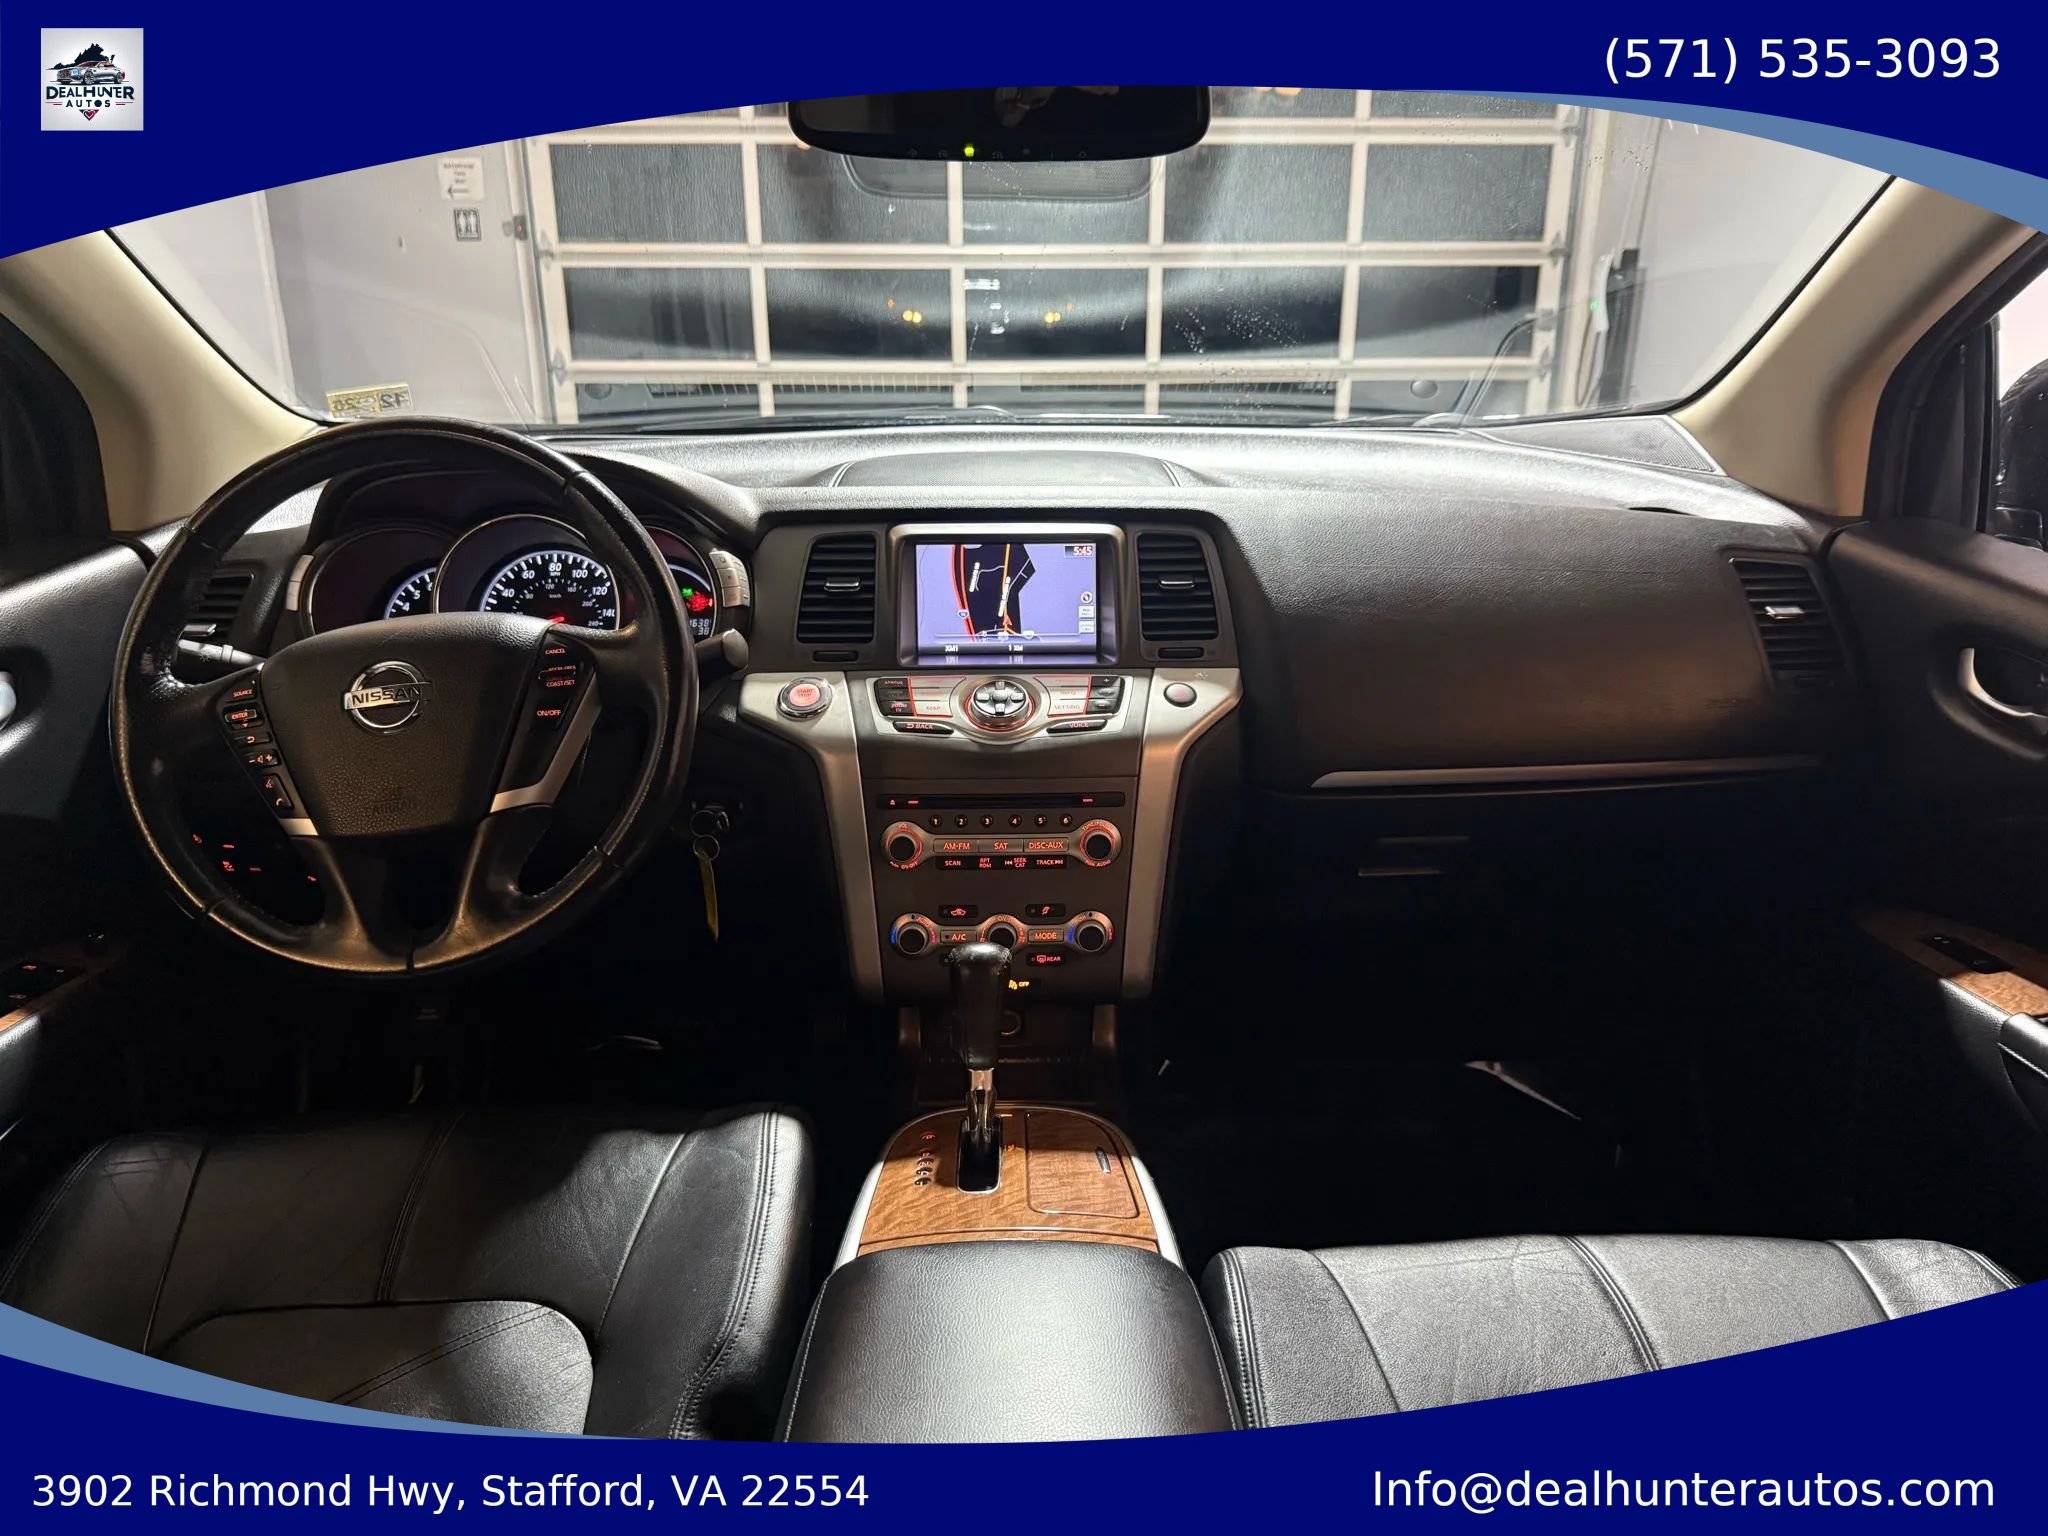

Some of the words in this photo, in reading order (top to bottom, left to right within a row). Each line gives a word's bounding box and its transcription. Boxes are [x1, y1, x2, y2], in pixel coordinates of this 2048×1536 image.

[1073, 546, 1092, 556] 5:45
[549, 562, 562, 572] 80
[522, 570, 535, 579] 60
[572, 569, 588, 578] 100
[413, 590, 421, 600] 5
[502, 588, 515, 598] 40
[592, 586, 608, 596] 120
[402, 602, 410, 612] 4
[352, 686, 421, 705] NISSAN
[994, 842, 1009, 850] SAT
[951, 933, 967, 941] A/C
[1034, 932, 1057, 940] MODE
